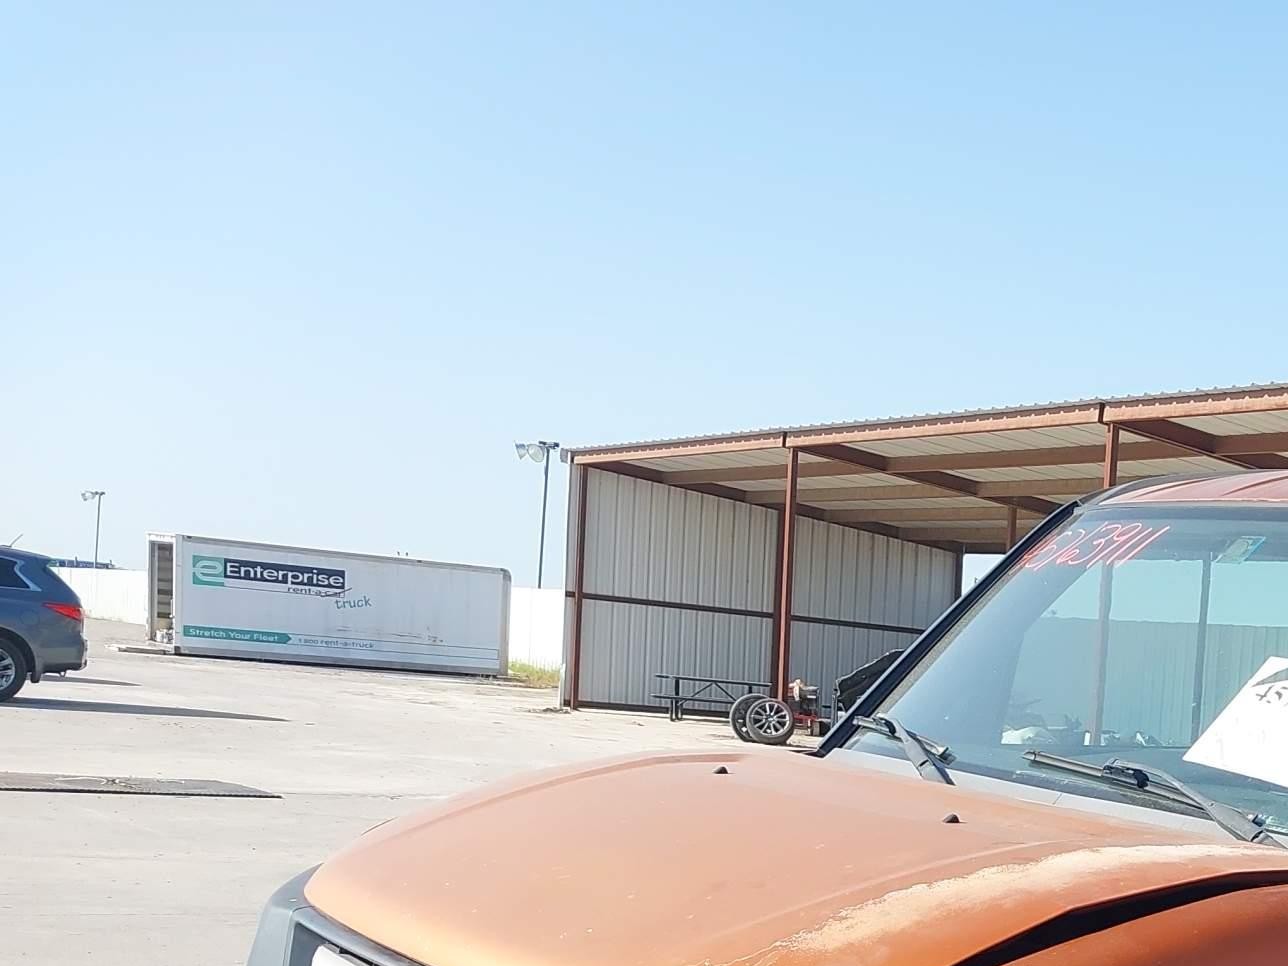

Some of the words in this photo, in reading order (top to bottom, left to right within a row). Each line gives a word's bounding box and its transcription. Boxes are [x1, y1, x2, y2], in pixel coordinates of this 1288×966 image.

[226, 562, 344, 587] Enterprise
[334, 596, 372, 610] truck
[189, 628, 226, 638] Stretch
[229, 631, 251, 640] Your
[253, 633, 278, 641] Fleet
